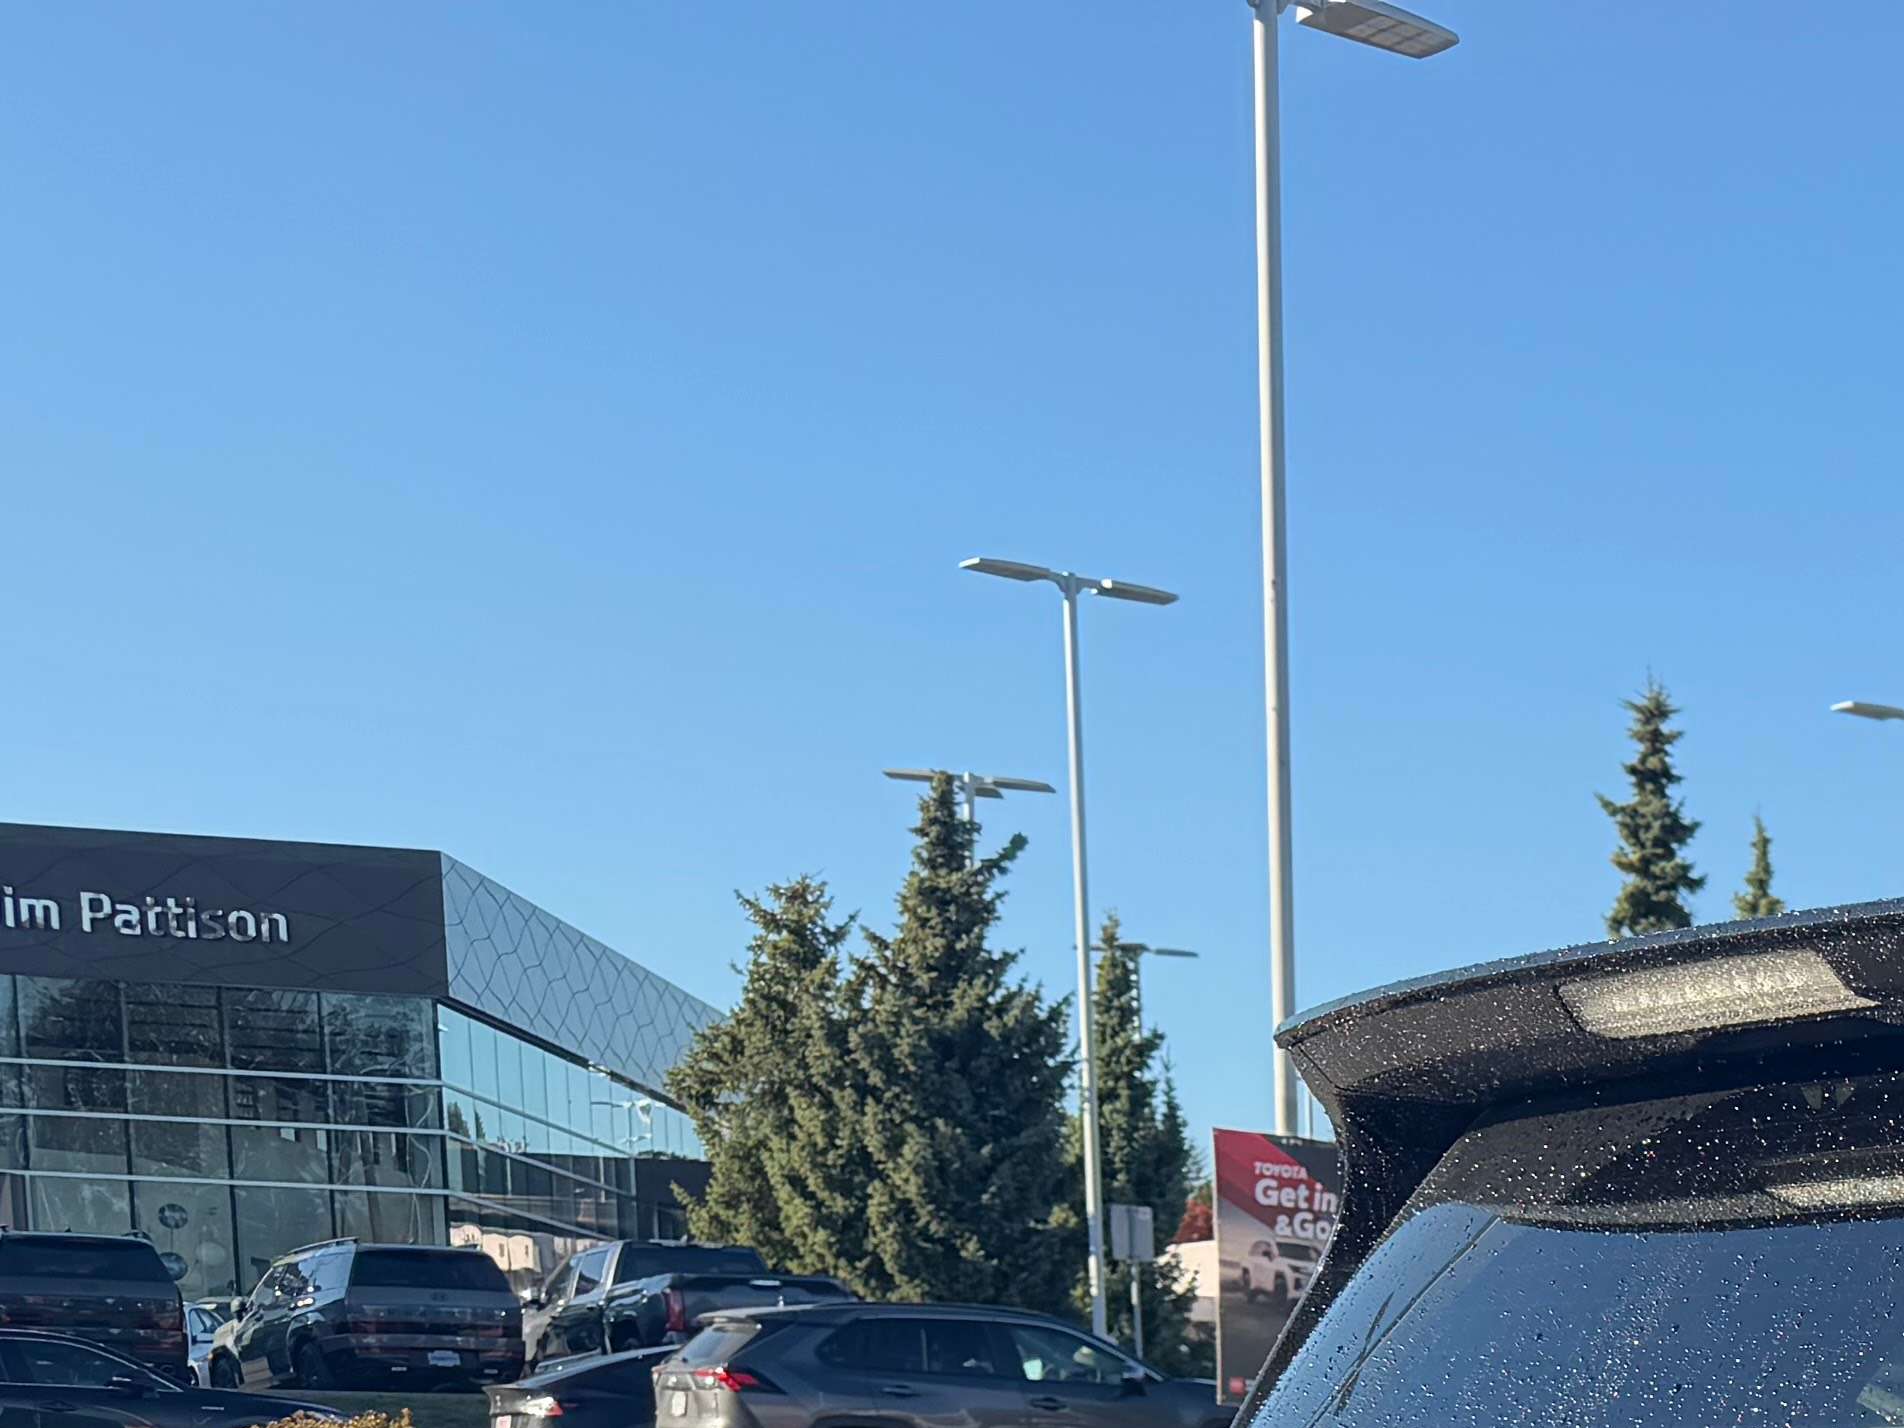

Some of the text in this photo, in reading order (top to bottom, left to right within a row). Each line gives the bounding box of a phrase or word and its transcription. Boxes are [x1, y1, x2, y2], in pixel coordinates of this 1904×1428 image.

[80, 891, 289, 943] Pattison
[1253, 1161, 1308, 1180] TOYOTA
[1255, 1178, 1340, 1213] Get in
